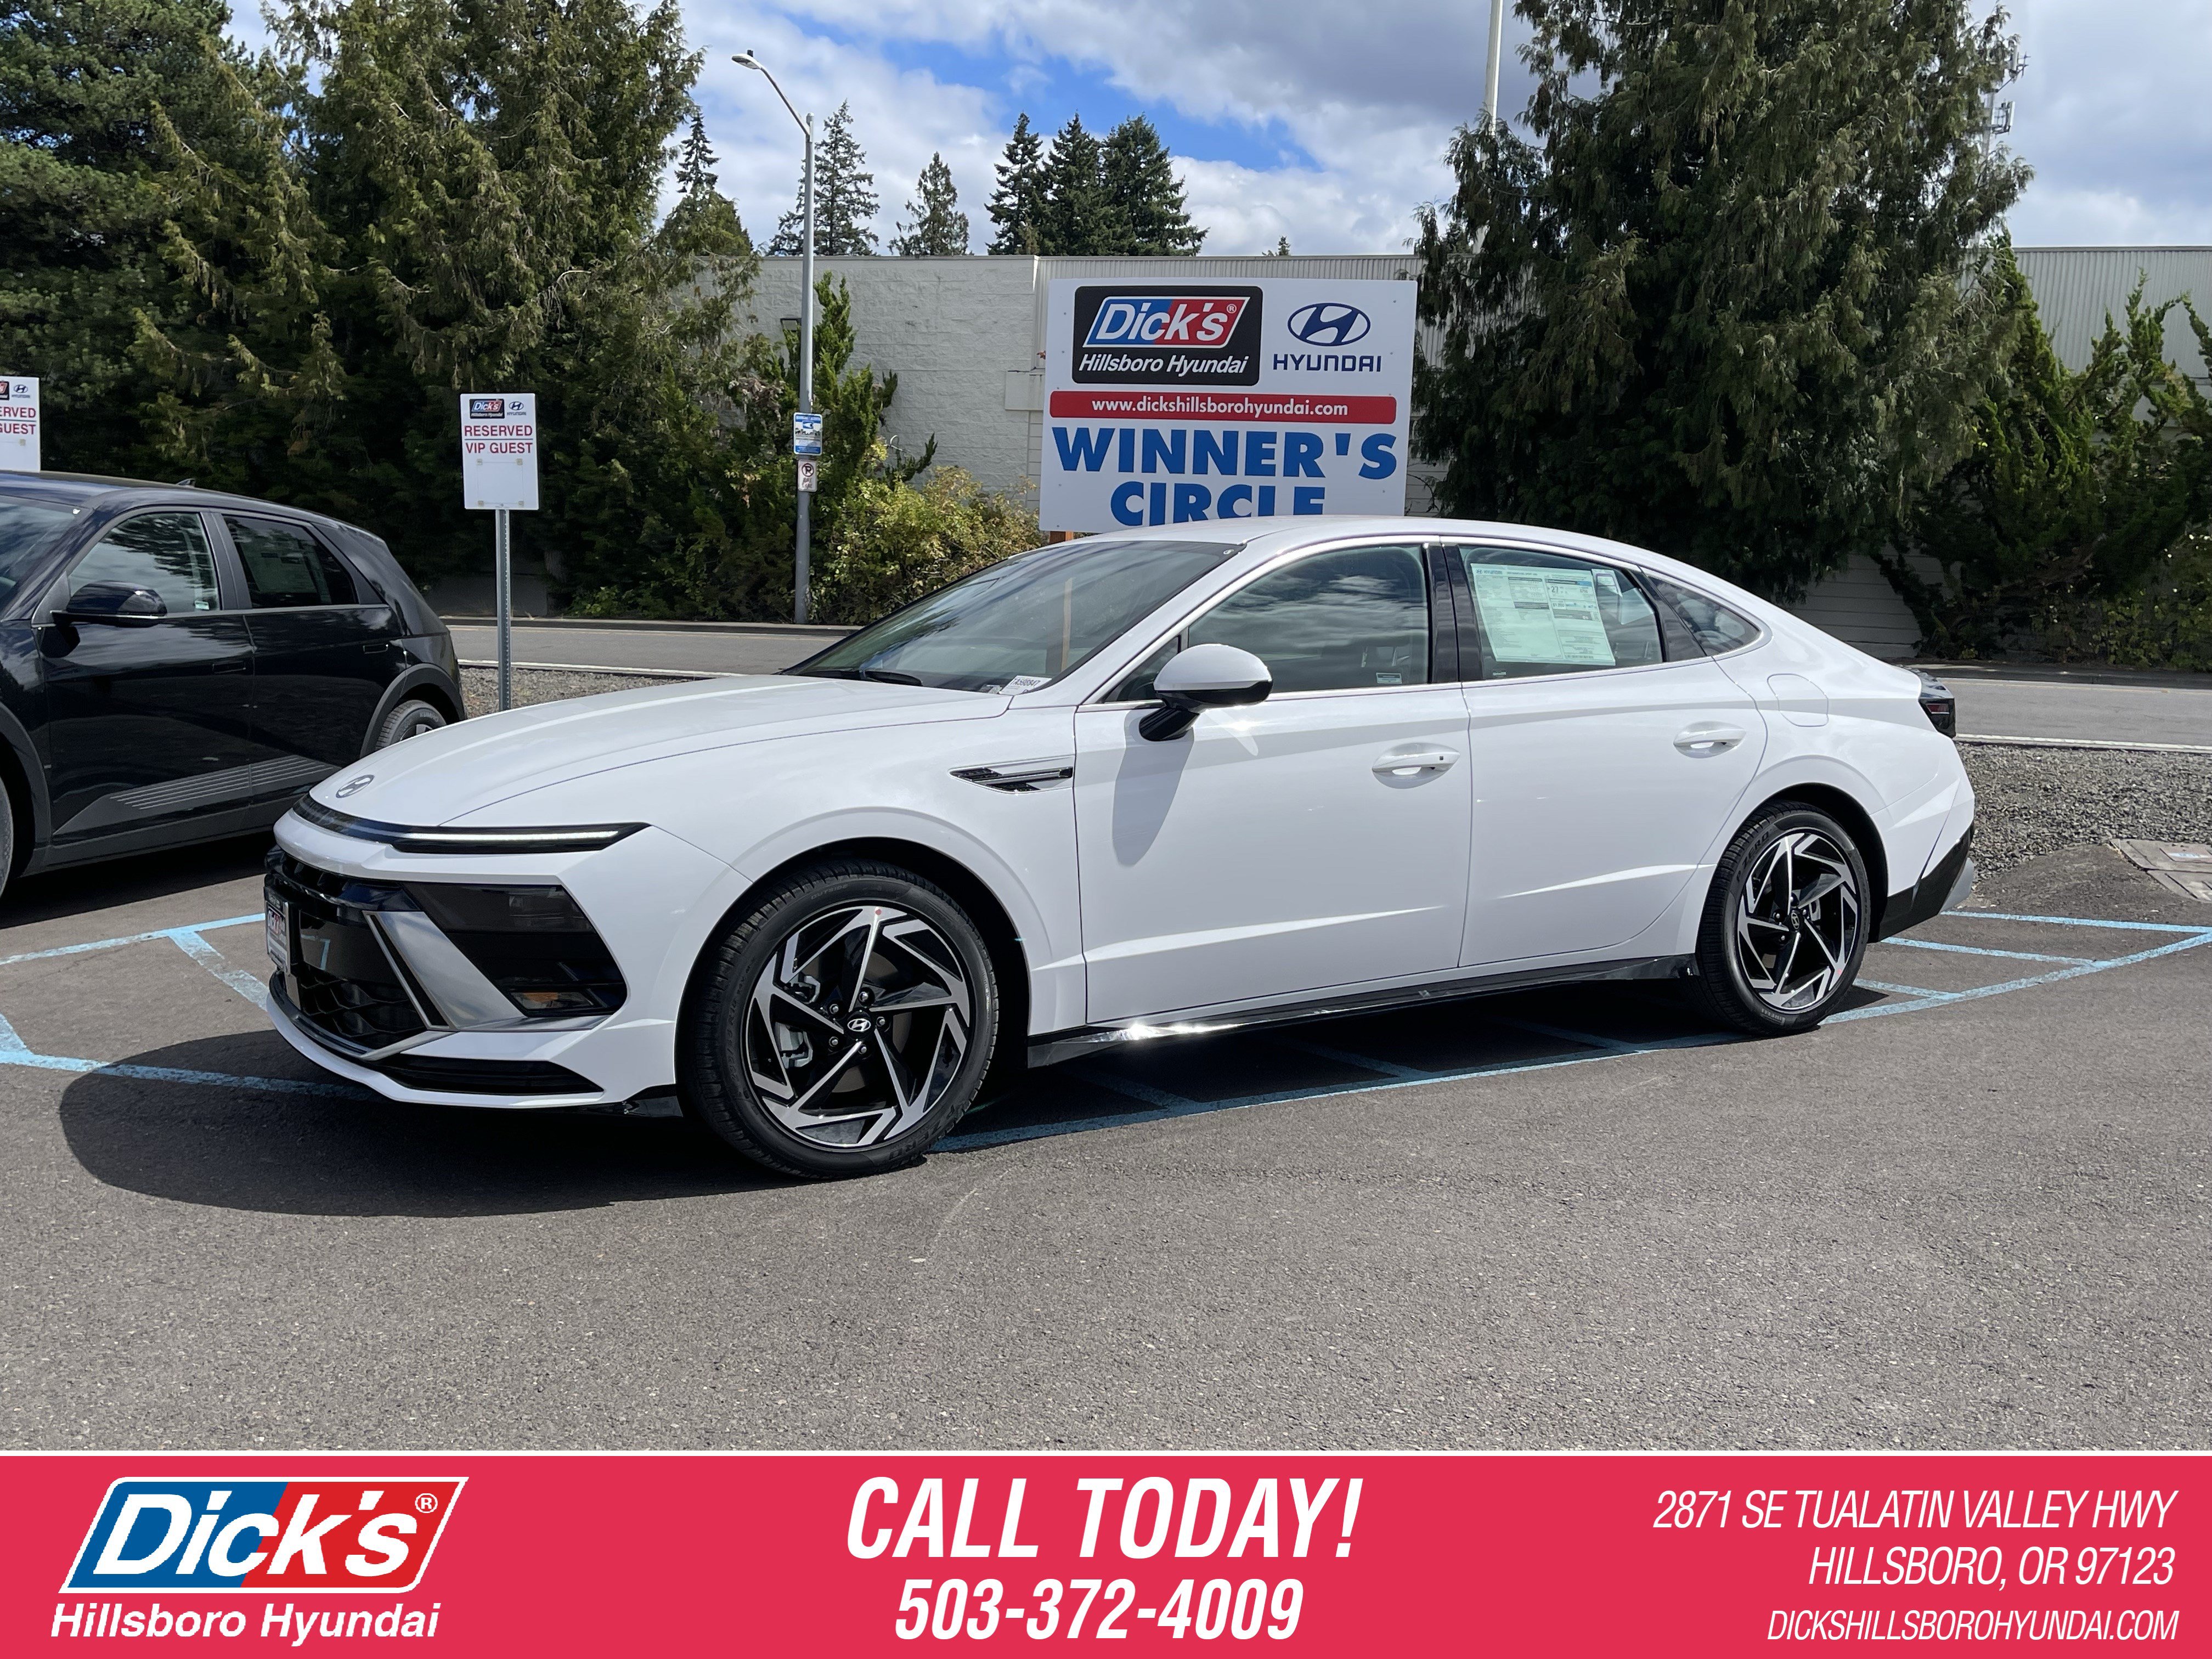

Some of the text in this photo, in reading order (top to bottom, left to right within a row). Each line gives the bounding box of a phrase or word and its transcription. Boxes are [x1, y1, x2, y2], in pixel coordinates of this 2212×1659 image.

[1096, 302, 1227, 341] Dick's
[1078, 354, 1250, 377] Hillsboro Hyundai
[1273, 354, 1381, 372] HYUNDAI
[474, 401, 499, 410] Dick's
[1092, 396, 1348, 418] www.dickshillsborohyundai.com
[464, 425, 533, 436] RESERVED
[466, 442, 533, 454] VIP GUEST
[1052, 427, 1397, 480] WINNER'S
[810, 884, 848, 900] OUTSIDE
